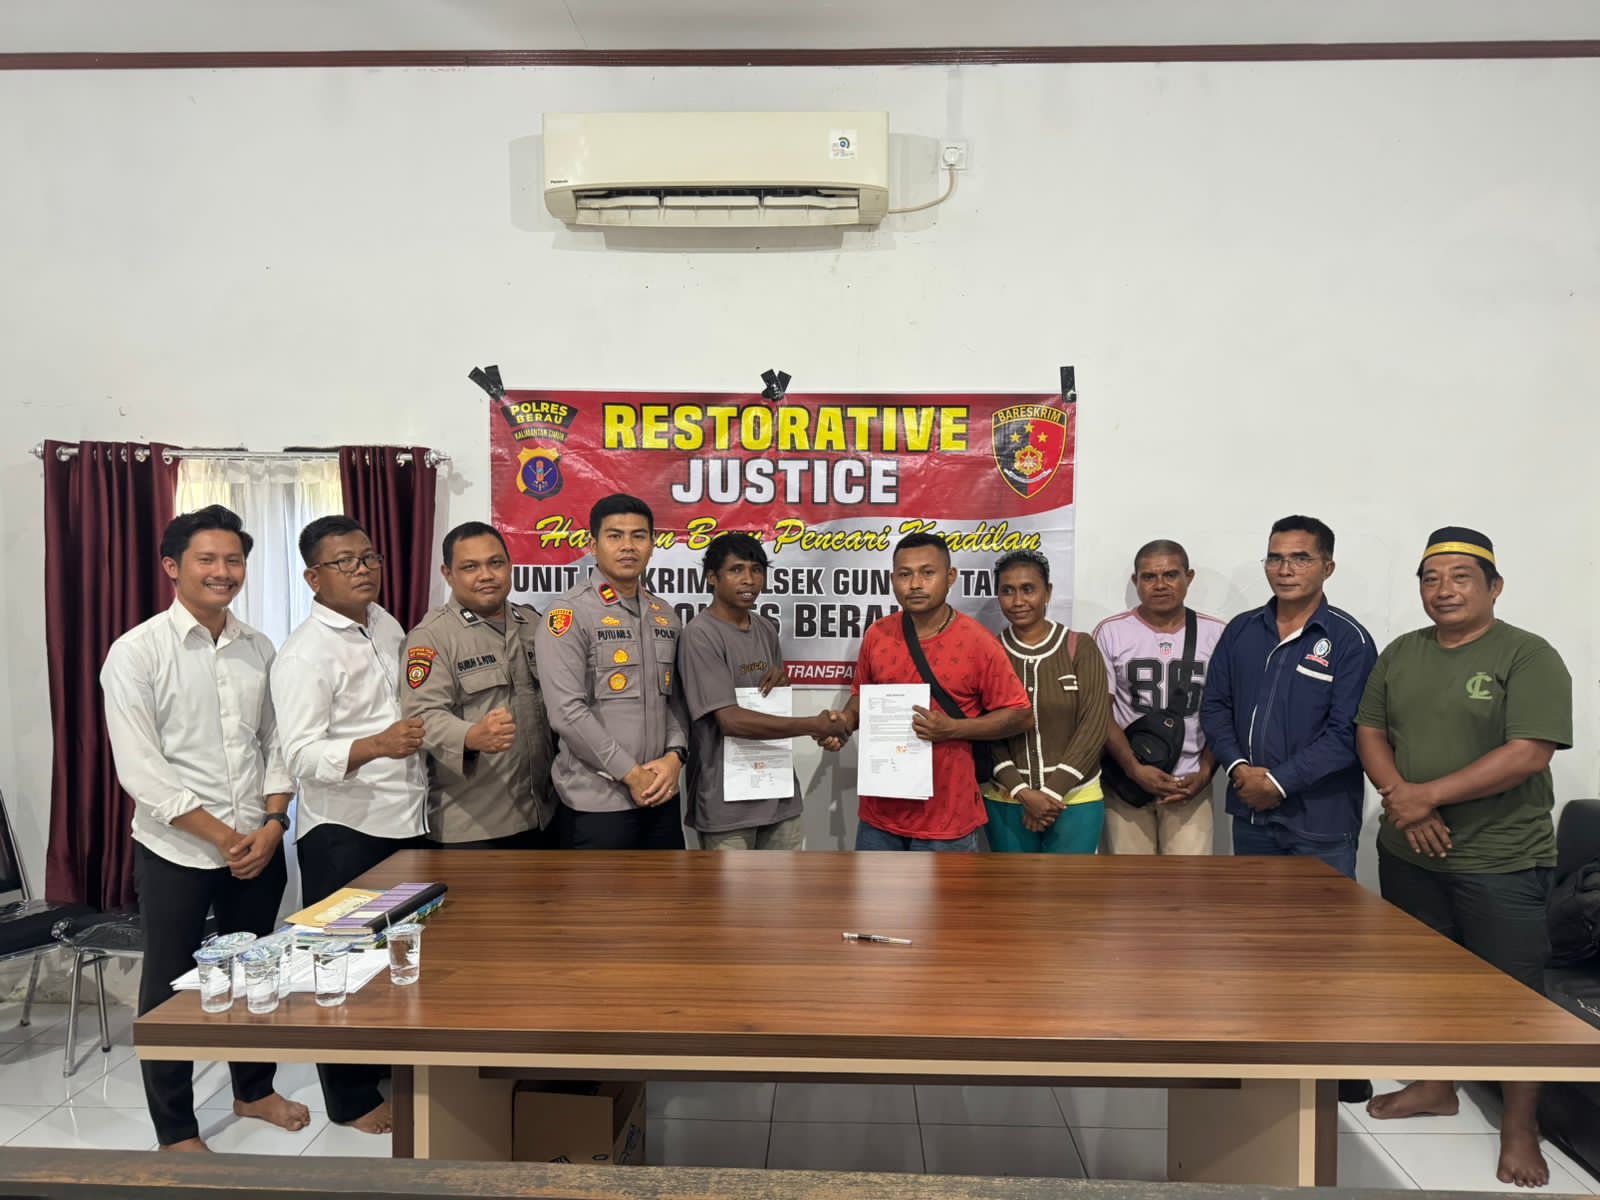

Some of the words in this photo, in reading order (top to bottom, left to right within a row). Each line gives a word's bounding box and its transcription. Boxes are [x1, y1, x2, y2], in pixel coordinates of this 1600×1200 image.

[510, 401, 568, 417] POLRES
[517, 413, 563, 425] BERAU
[998, 401, 1062, 423] BARESKRIM
[603, 403, 969, 451] RESTORATIVE
[671, 458, 898, 505] JUSTICE
[774, 518, 890, 553] Pencari
[513, 566, 578, 593] UNIT
[794, 603, 900, 638] BERA
[787, 665, 857, 679] TRANSPA
